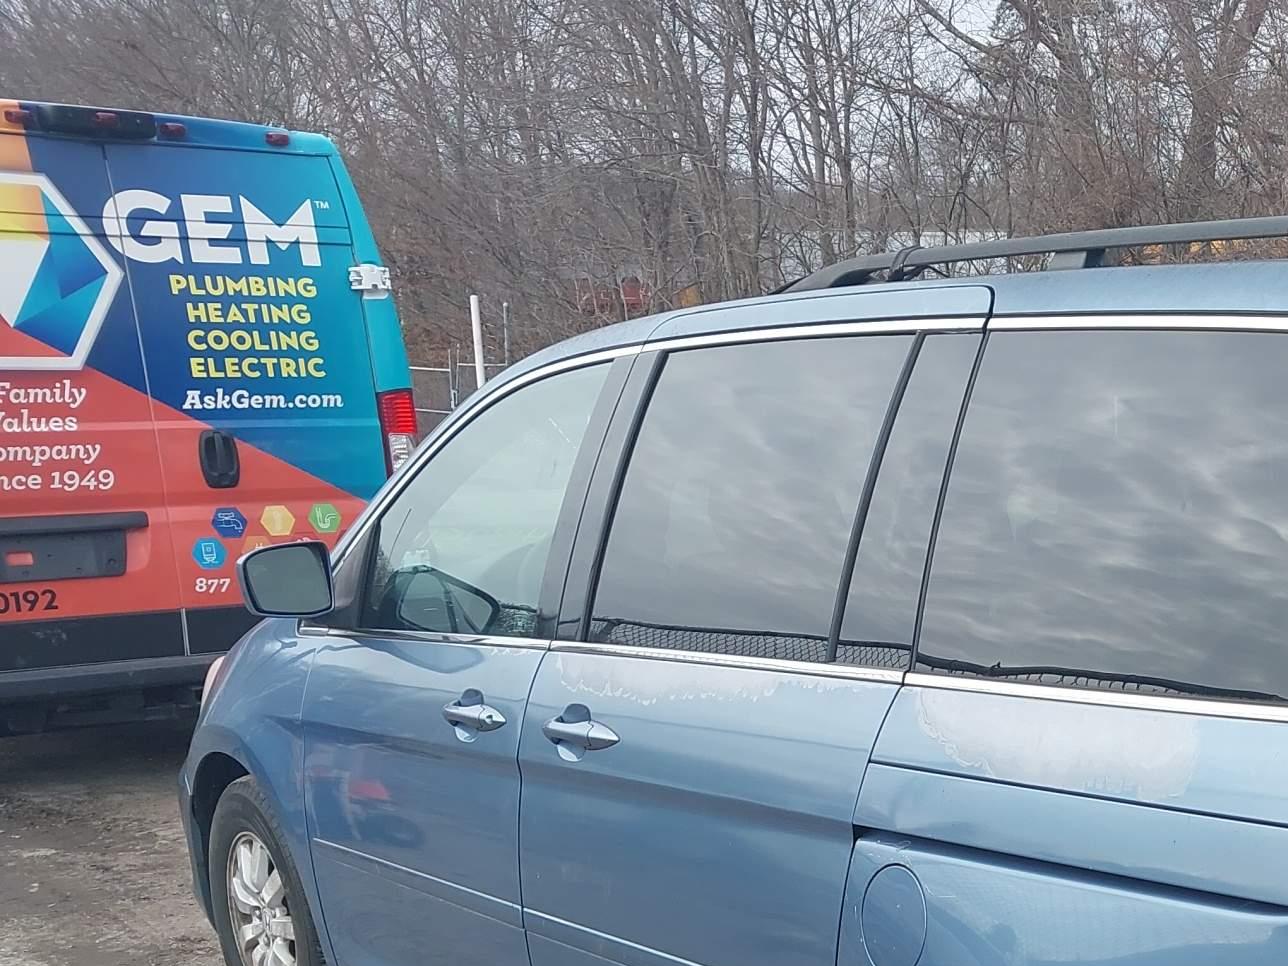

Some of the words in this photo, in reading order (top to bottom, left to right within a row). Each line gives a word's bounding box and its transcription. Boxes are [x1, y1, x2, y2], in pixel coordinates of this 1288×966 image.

[102, 189, 321, 266] GEM
[169, 274, 318, 298] PLUMBING
[186, 302, 312, 324] HEATING
[187, 329, 320, 351] COOLING
[189, 357, 327, 378] ELECTRIC
[182, 388, 344, 409] AskGem.com
[0, 409, 78, 432] alues
[0, 444, 101, 467] ompany
[0, 473, 42, 490] nce
[50, 469, 115, 491] 1949
[195, 577, 231, 593] 877
